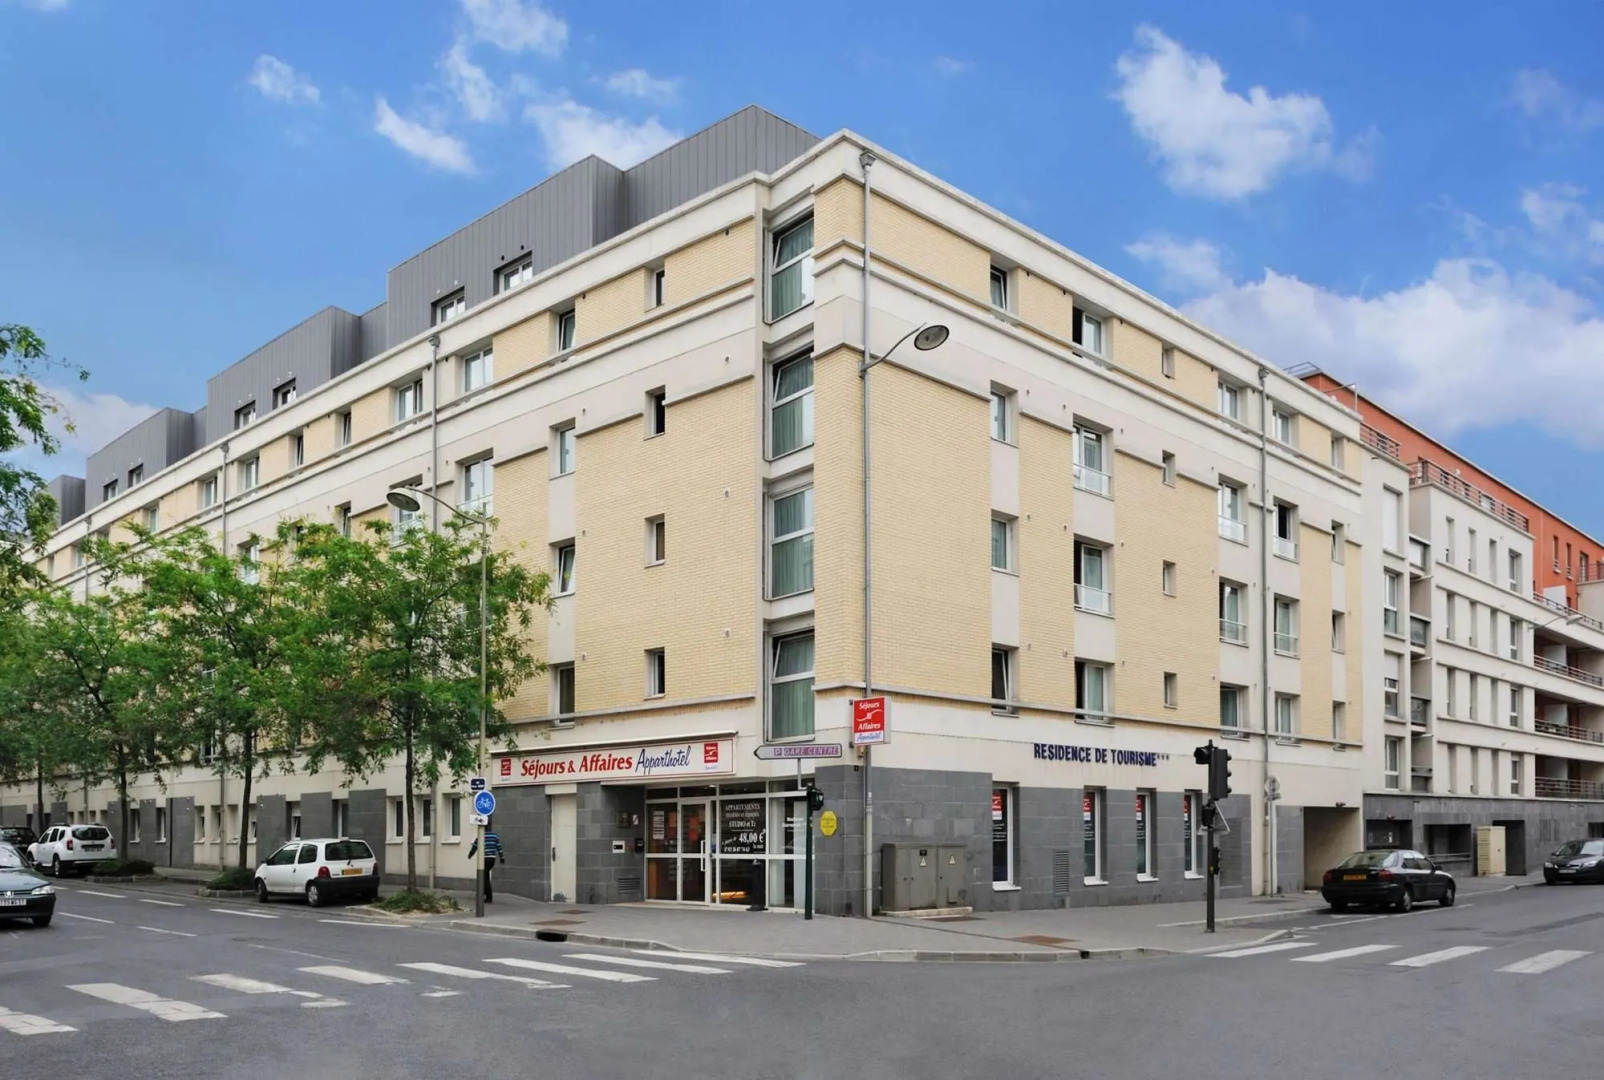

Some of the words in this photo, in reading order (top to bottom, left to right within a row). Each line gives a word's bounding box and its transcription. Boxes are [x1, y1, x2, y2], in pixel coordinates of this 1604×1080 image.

[859, 701, 880, 710] Séjours
[858, 722, 881, 731] Affaires
[784, 747, 805, 756] GARE
[808, 746, 838, 755] CENTRE
[1033, 743, 1092, 763] RESIDENCE
[1095, 748, 1108, 763] DE
[521, 759, 566, 780] Séjours
[567, 760, 576, 774] &
[579, 753, 633, 773] Affaires
[635, 745, 692, 776] Apparthotel
[738, 832, 758, 844] 48,00
